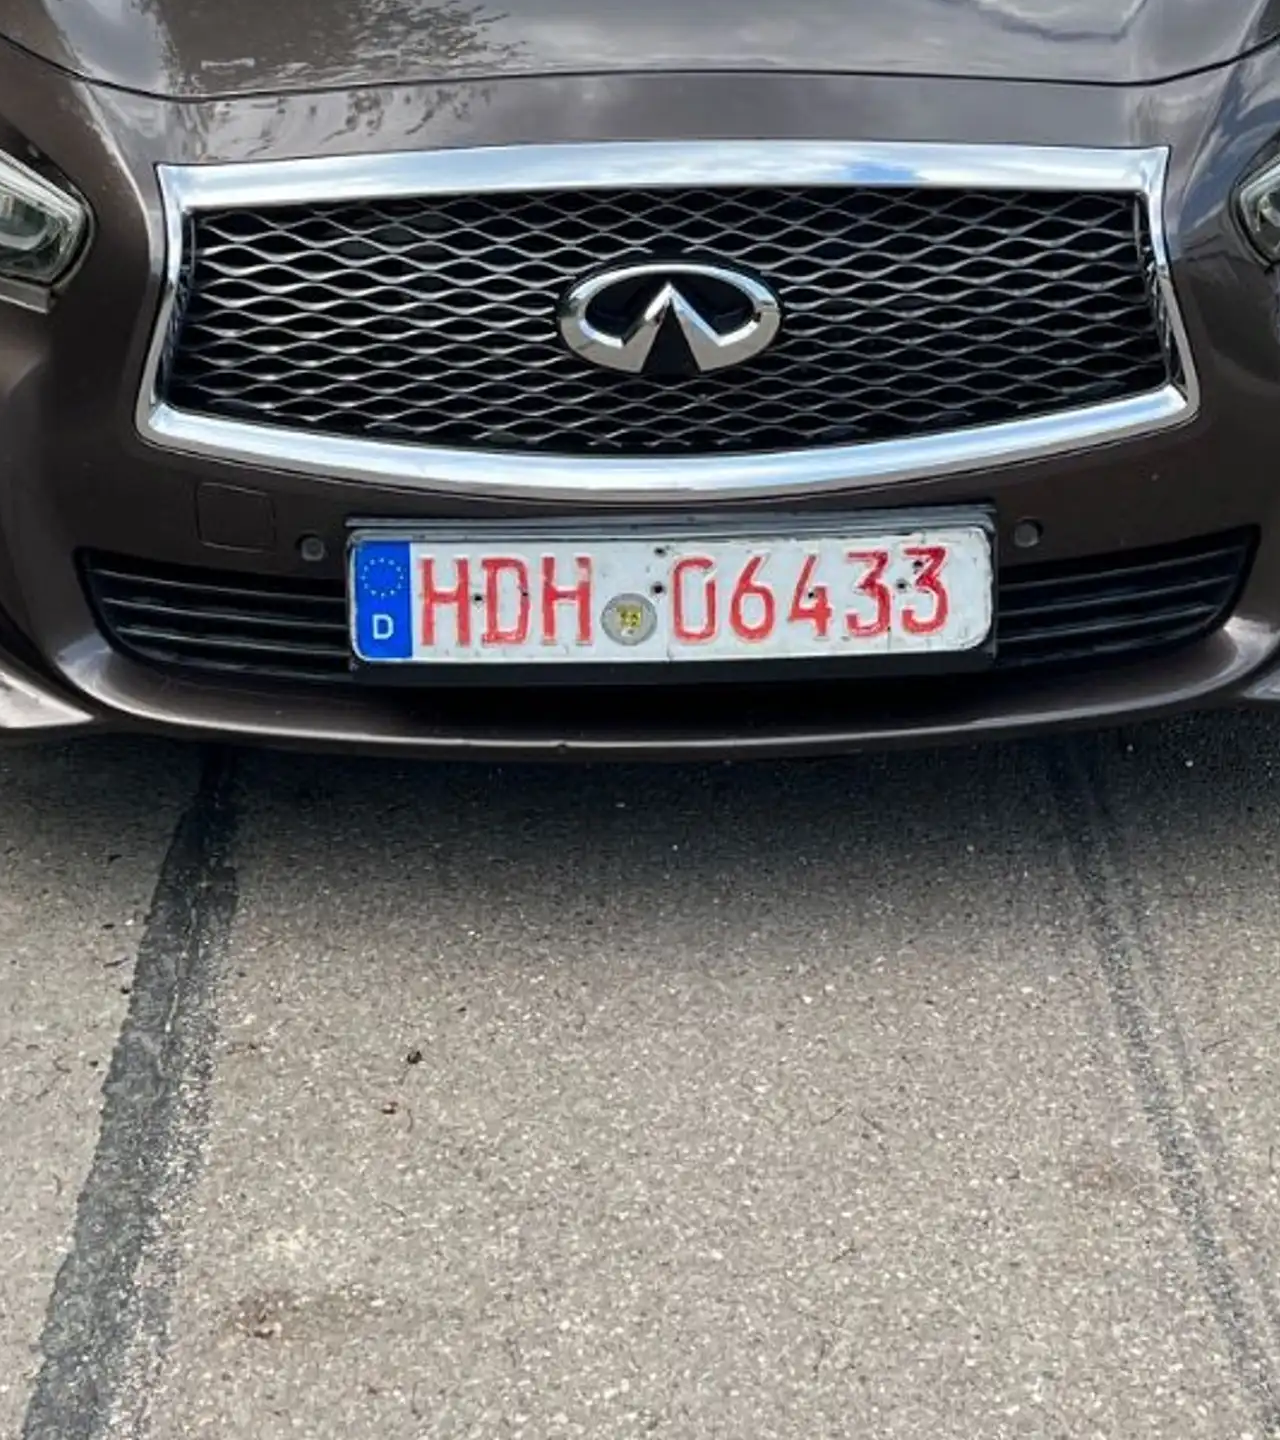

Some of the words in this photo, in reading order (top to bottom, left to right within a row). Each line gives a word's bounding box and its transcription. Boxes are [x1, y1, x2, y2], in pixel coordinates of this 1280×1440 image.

[371, 613, 395, 641] D
[418, 555, 594, 647] HDH
[671, 545, 949, 643] 06433
